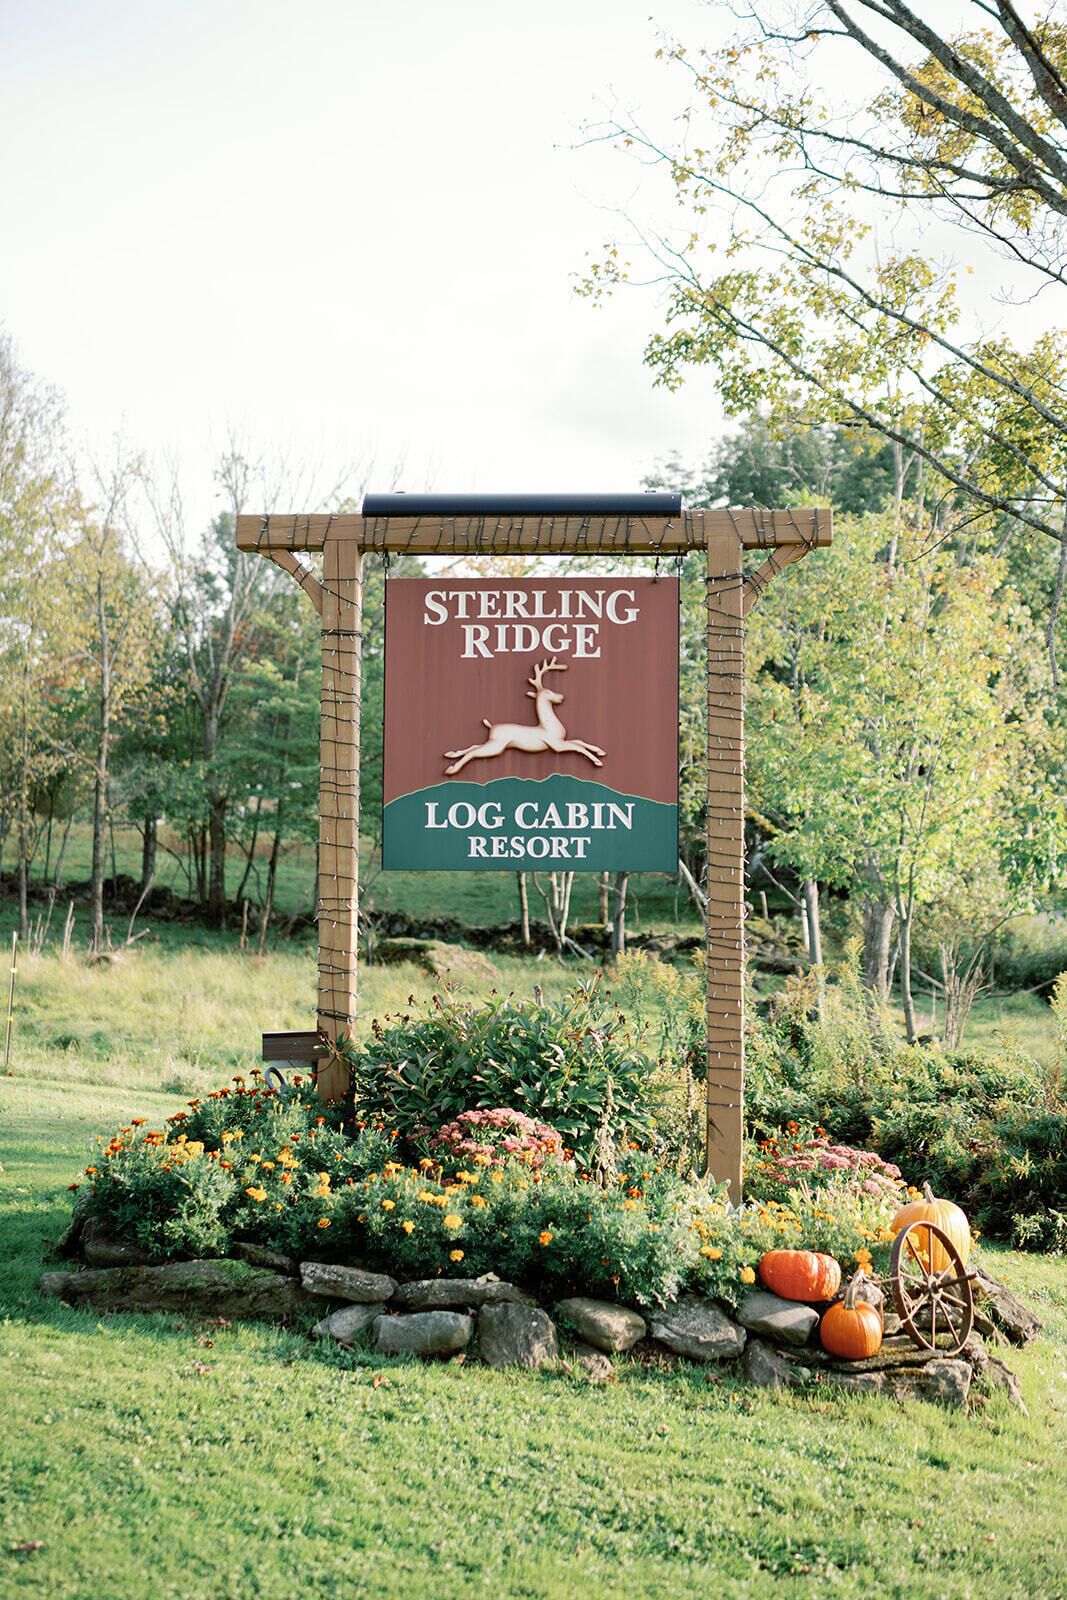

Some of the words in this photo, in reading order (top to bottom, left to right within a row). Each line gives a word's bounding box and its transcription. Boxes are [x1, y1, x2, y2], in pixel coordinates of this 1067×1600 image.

[423, 589, 640, 625] STERLING
[460, 623, 601, 659] RIDGE
[424, 801, 505, 829] LOG
[514, 801, 636, 830] CABIN
[467, 836, 592, 858] RESORT
